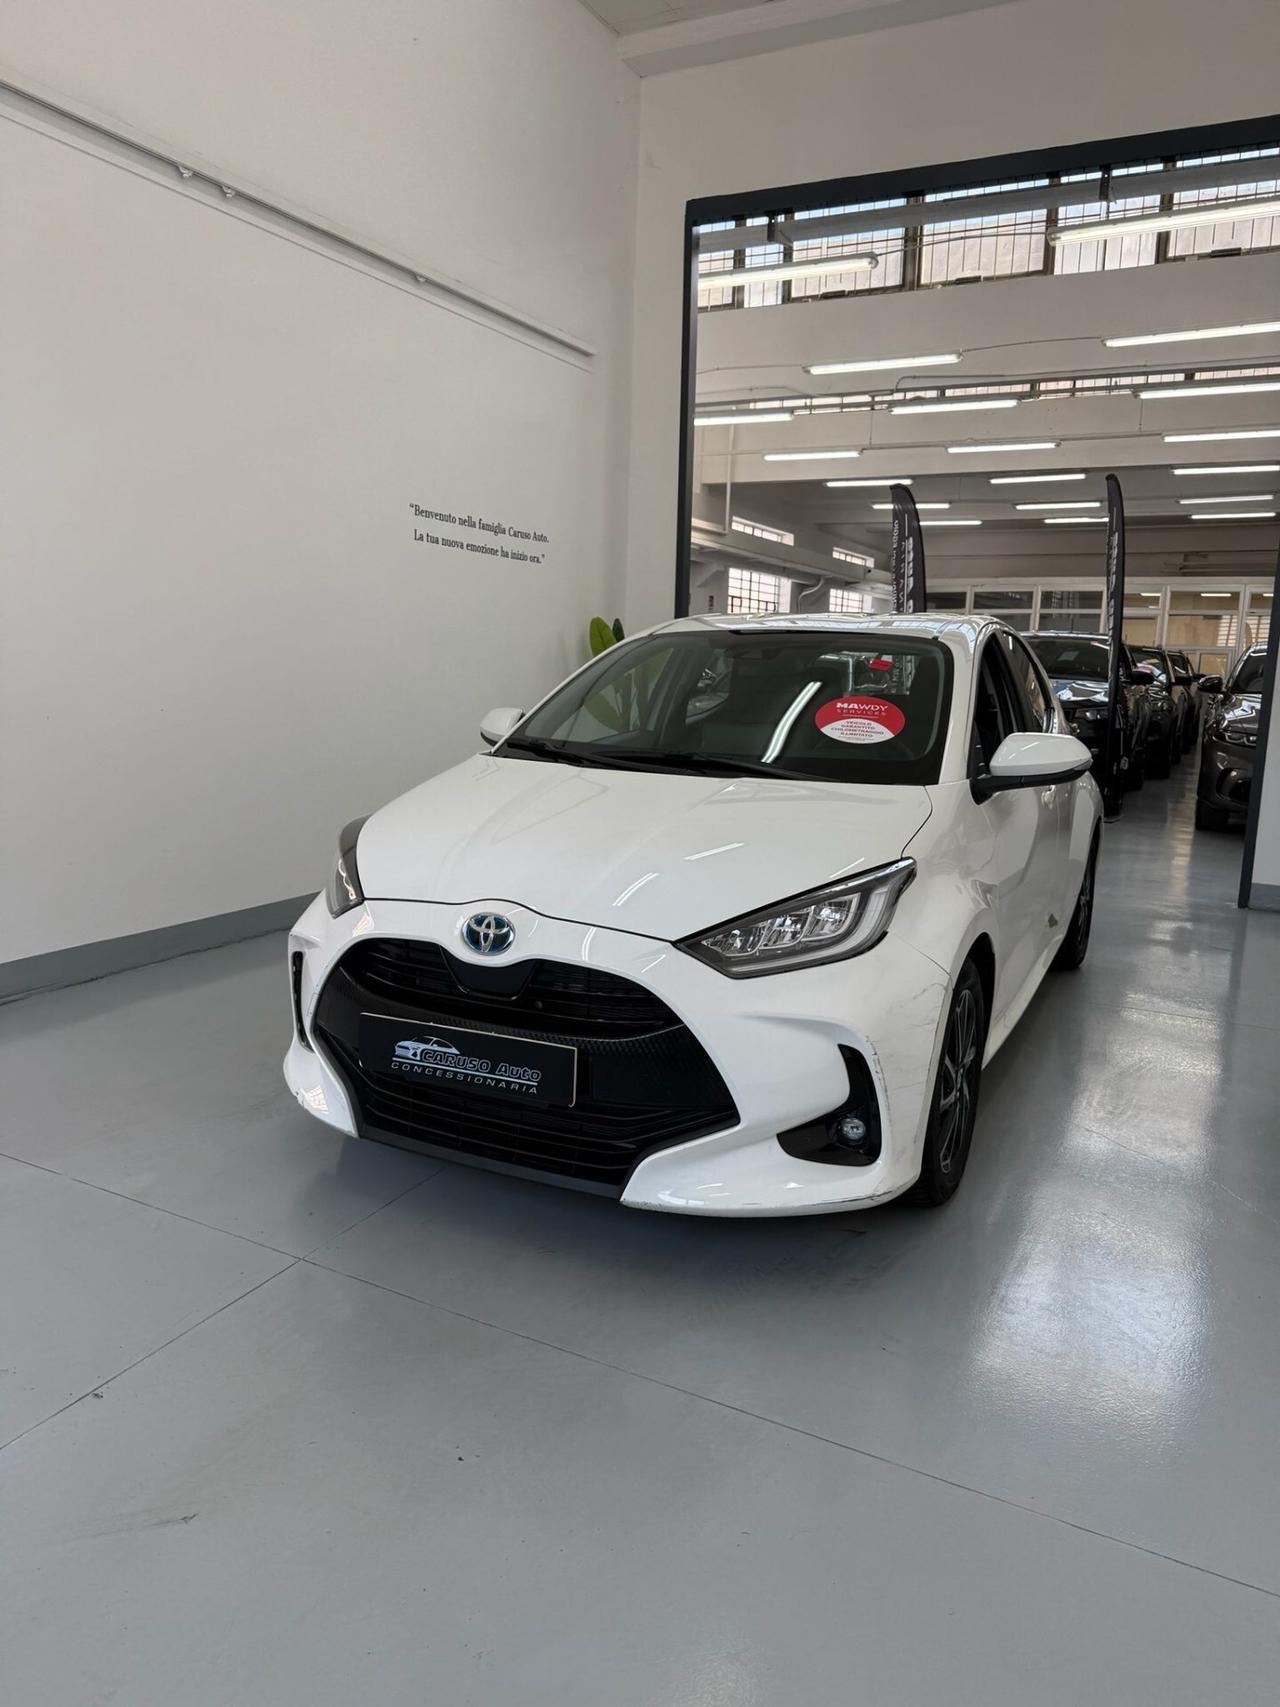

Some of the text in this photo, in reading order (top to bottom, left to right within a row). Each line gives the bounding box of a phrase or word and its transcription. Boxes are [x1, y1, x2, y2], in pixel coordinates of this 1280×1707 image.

[458, 515, 476, 529] nella
[478, 518, 506, 536] famiglia
[508, 526, 531, 541] Caruso
[532, 531, 549, 543] Auto.
[414, 528, 424, 542] La
[426, 532, 439, 545] tua
[441, 537, 464, 550] nuova
[466, 544, 499, 557] emozione
[500, 546, 509, 559] ha
[510, 549, 528, 562] inizio
[836, 702, 888, 711] MAWDY
[421, 1049, 491, 1073] CARUSO
[391, 1061, 538, 1094] CONCESSIONARIA
